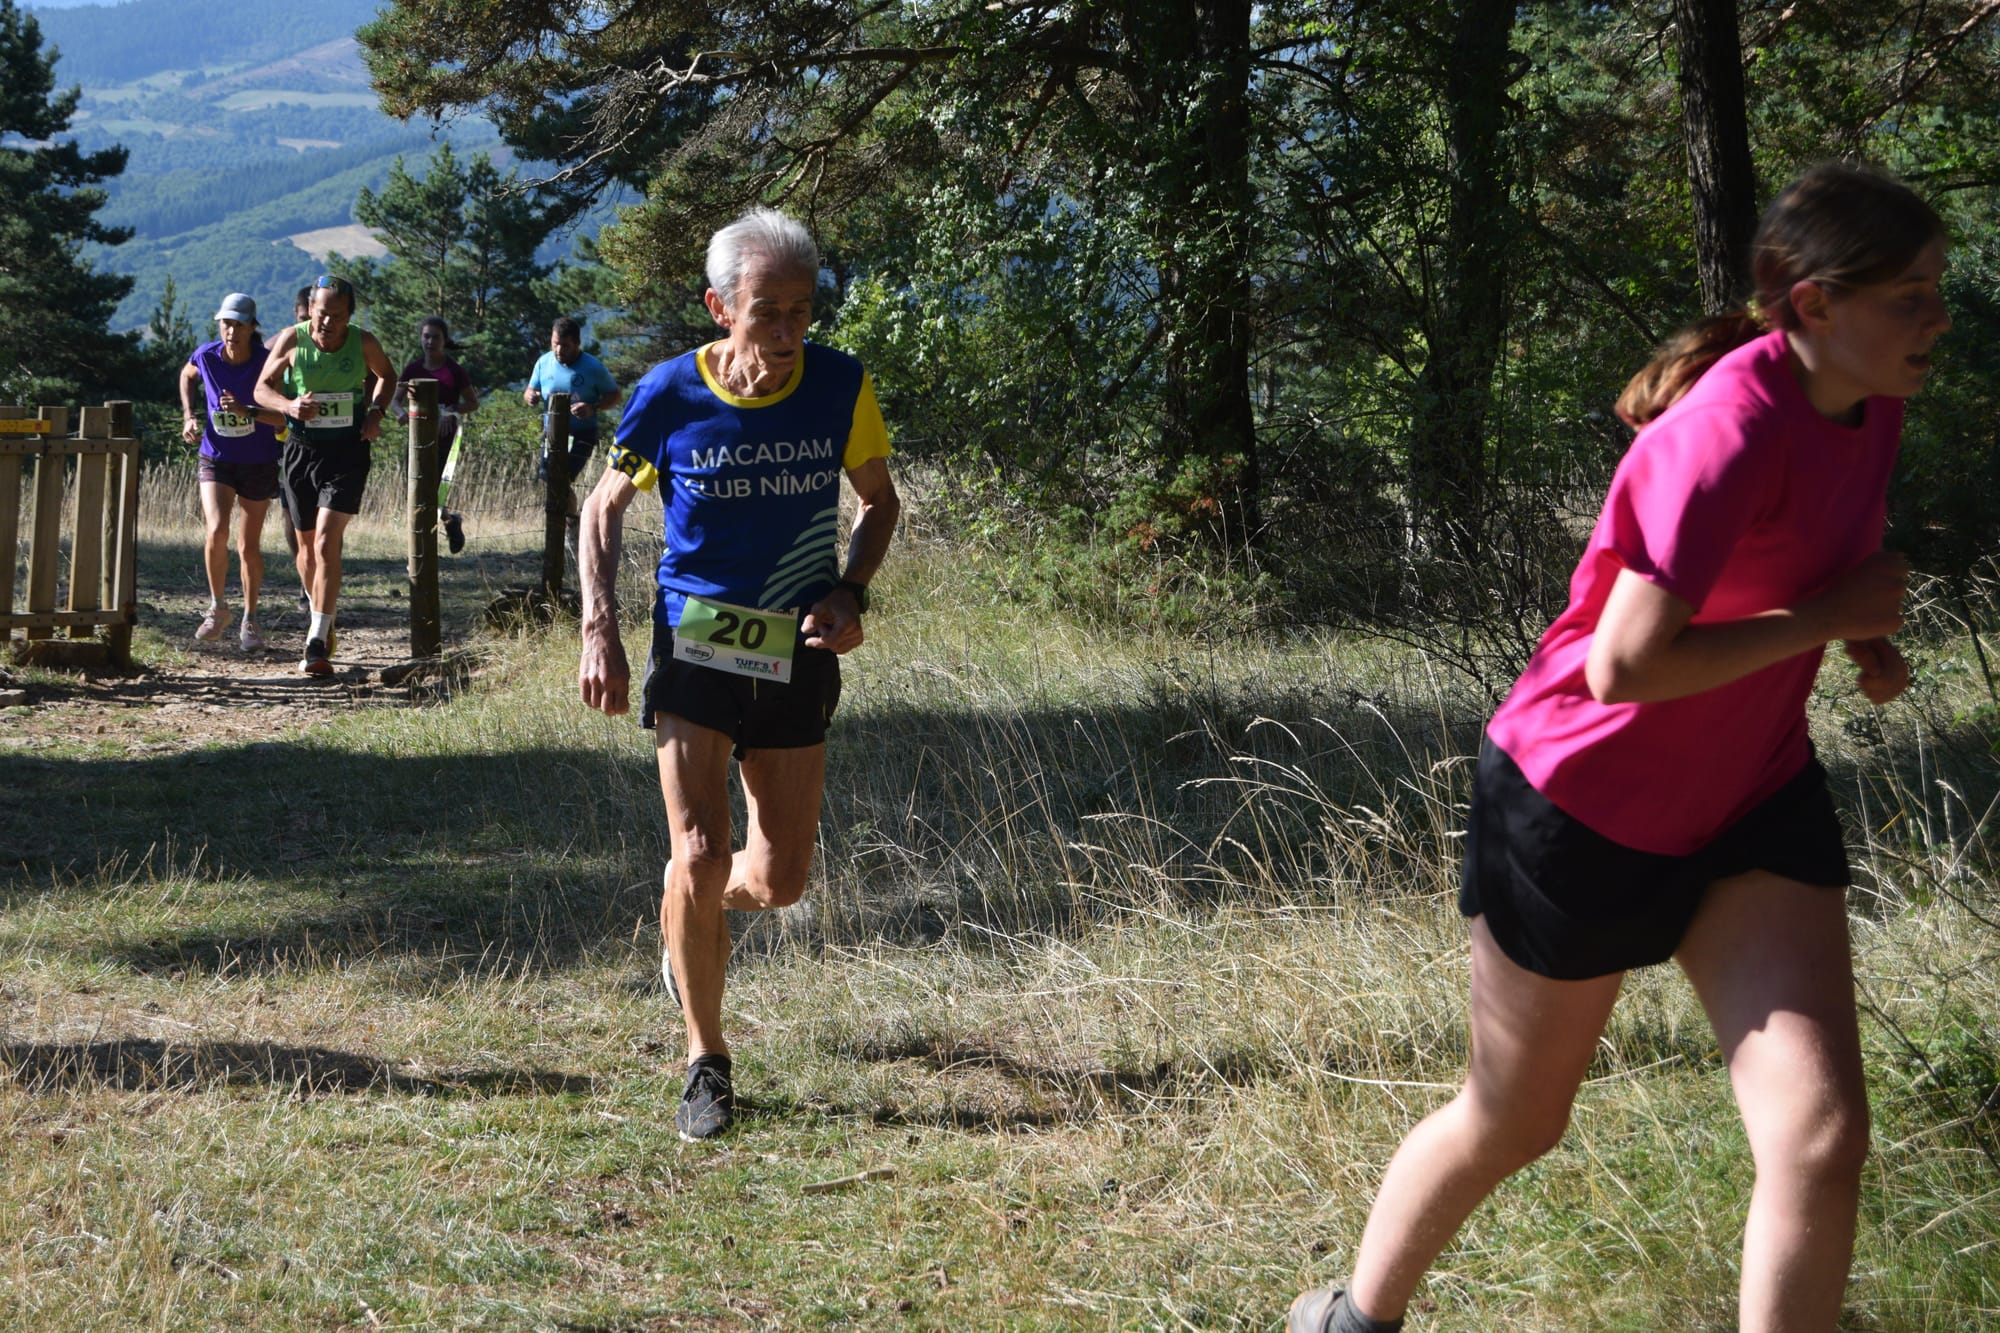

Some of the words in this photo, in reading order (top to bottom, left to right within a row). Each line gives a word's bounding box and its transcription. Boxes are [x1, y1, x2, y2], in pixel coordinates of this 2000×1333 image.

[319, 402, 339, 416] 61
[691, 437, 833, 469] MACADAM
[708, 611, 767, 650] 20
